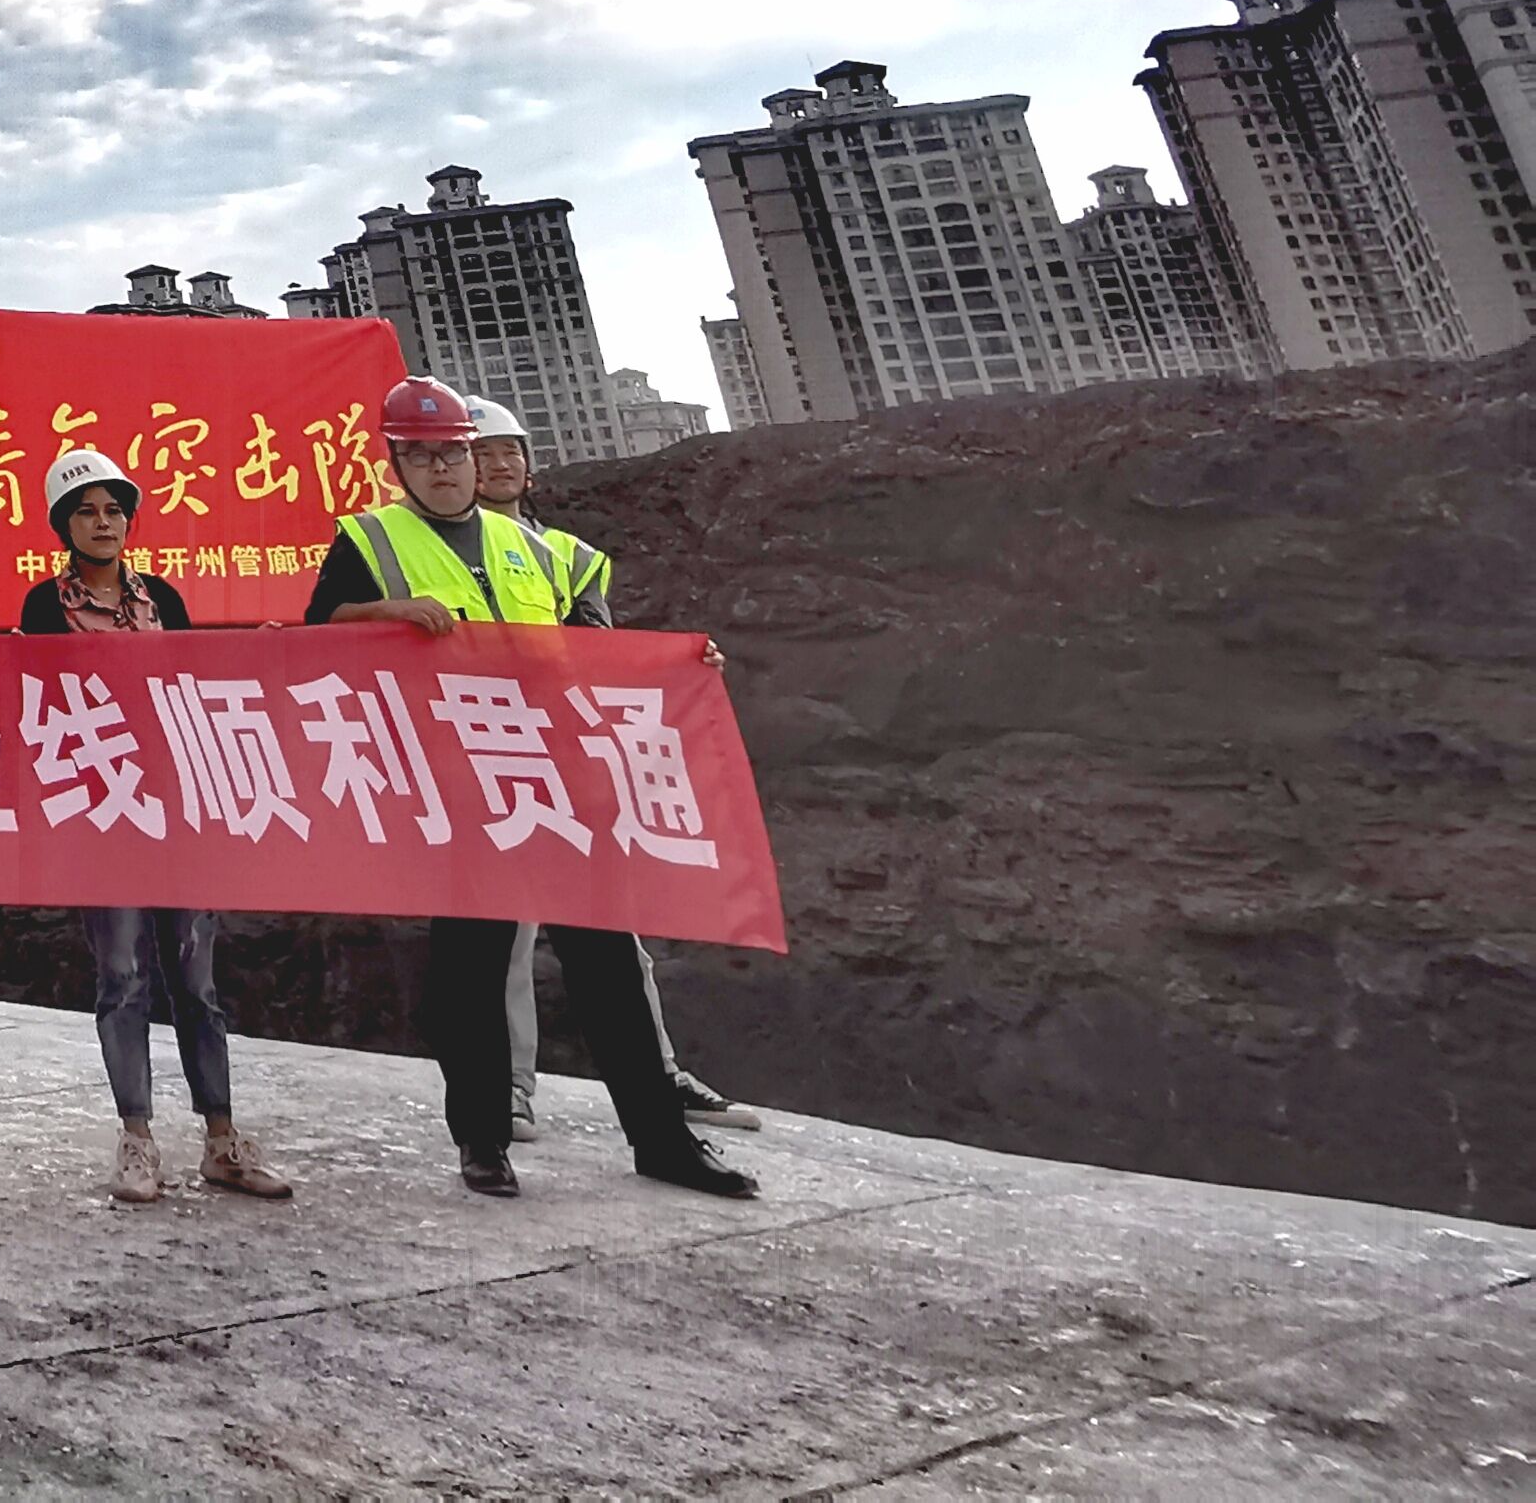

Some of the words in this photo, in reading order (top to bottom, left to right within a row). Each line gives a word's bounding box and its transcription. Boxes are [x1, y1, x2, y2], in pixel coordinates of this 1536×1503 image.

[15, 543, 331, 583] 中建道开州管廊项
